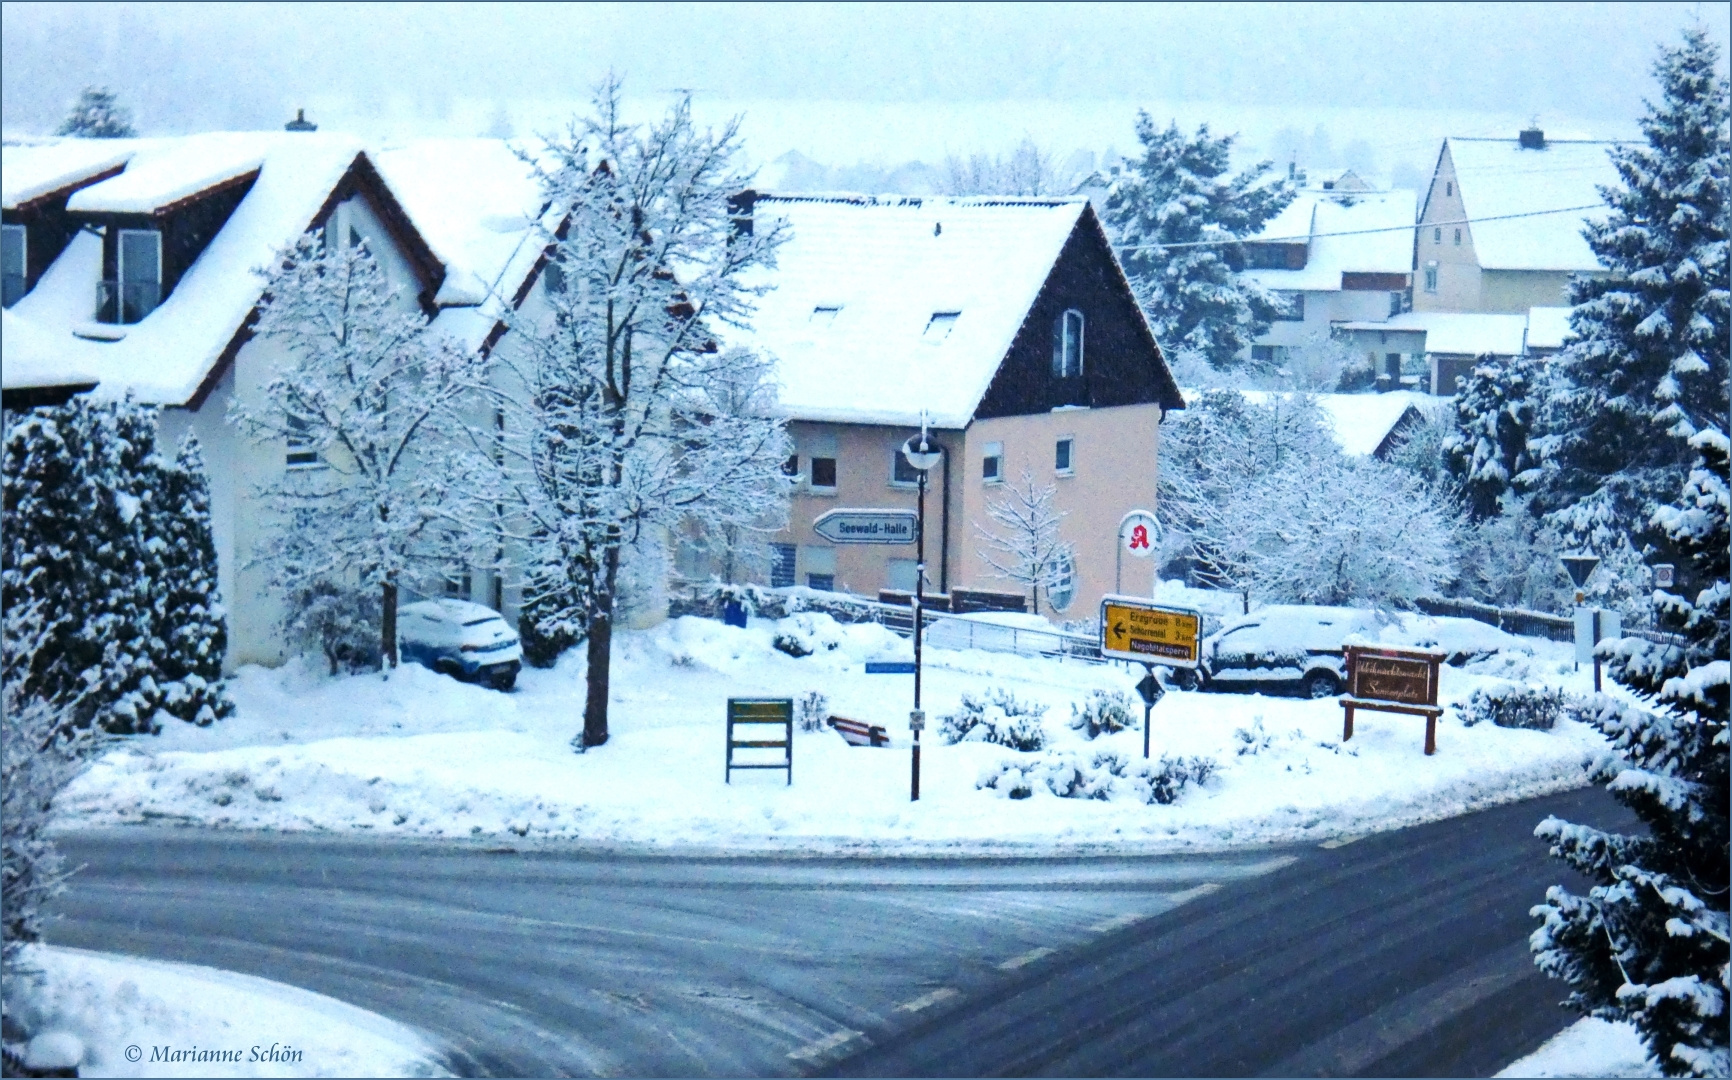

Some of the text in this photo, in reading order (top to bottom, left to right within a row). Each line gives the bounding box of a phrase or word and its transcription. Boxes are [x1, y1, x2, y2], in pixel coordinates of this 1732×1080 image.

[839, 522, 908, 534] Seewald-Halle
[1130, 611, 1169, 626] Erzgrube
[1175, 617, 1181, 627] 8
[1175, 630, 1181, 641] 3
[1131, 640, 1189, 657] Nagoldtalsperre
